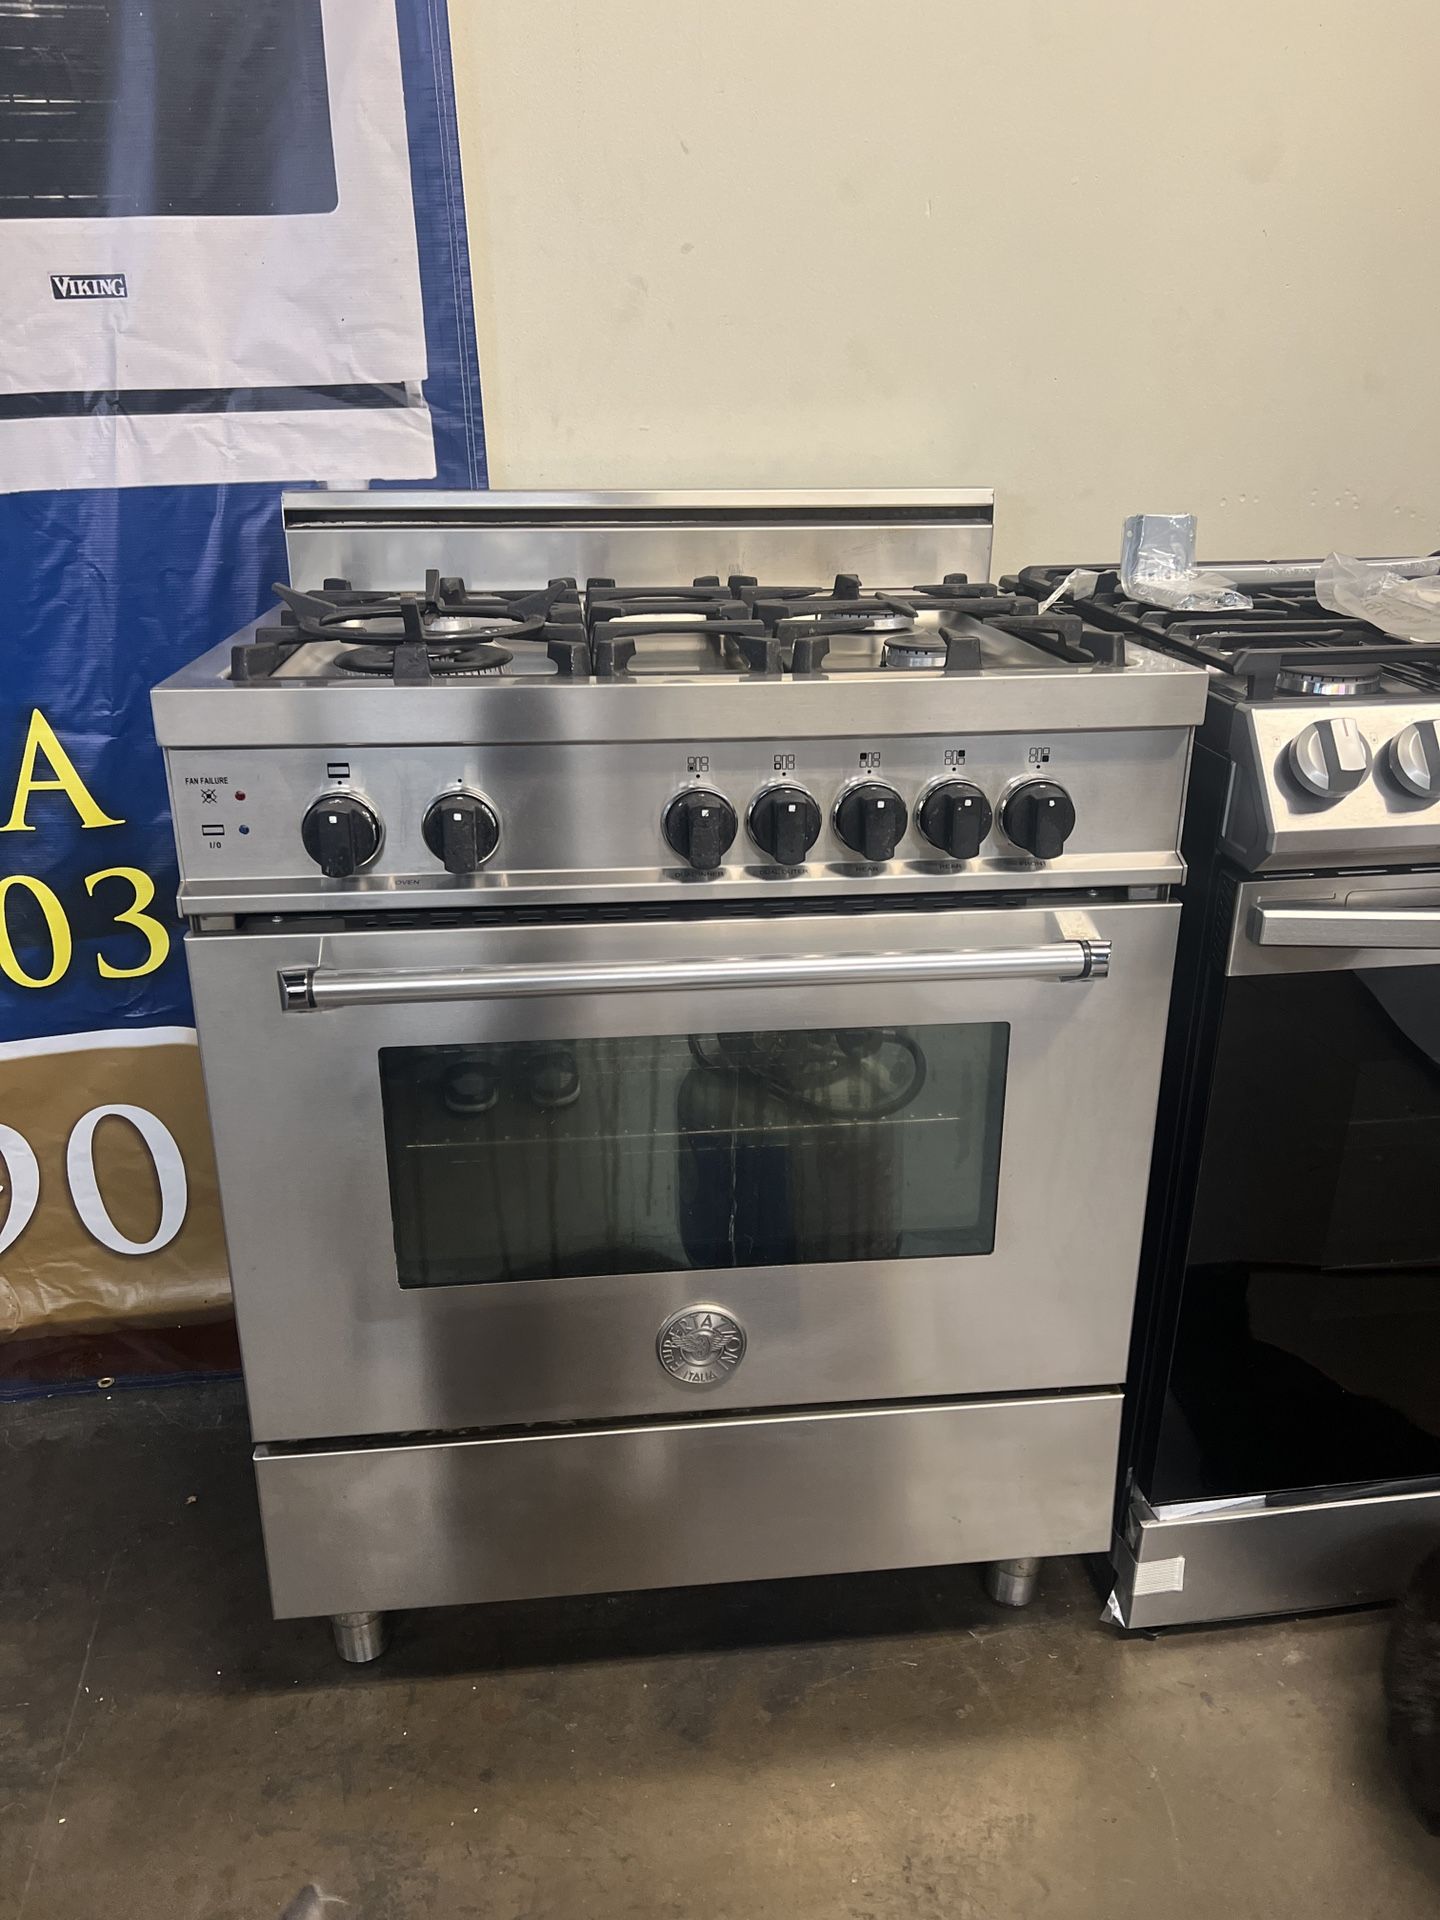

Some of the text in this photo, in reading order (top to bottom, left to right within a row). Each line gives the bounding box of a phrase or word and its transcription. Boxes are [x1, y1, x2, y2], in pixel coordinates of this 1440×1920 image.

[52, 277, 125, 297] VIKING
[185, 776, 229, 785] FAN FAILURE
[683, 1370, 718, 1382] ITALIA
